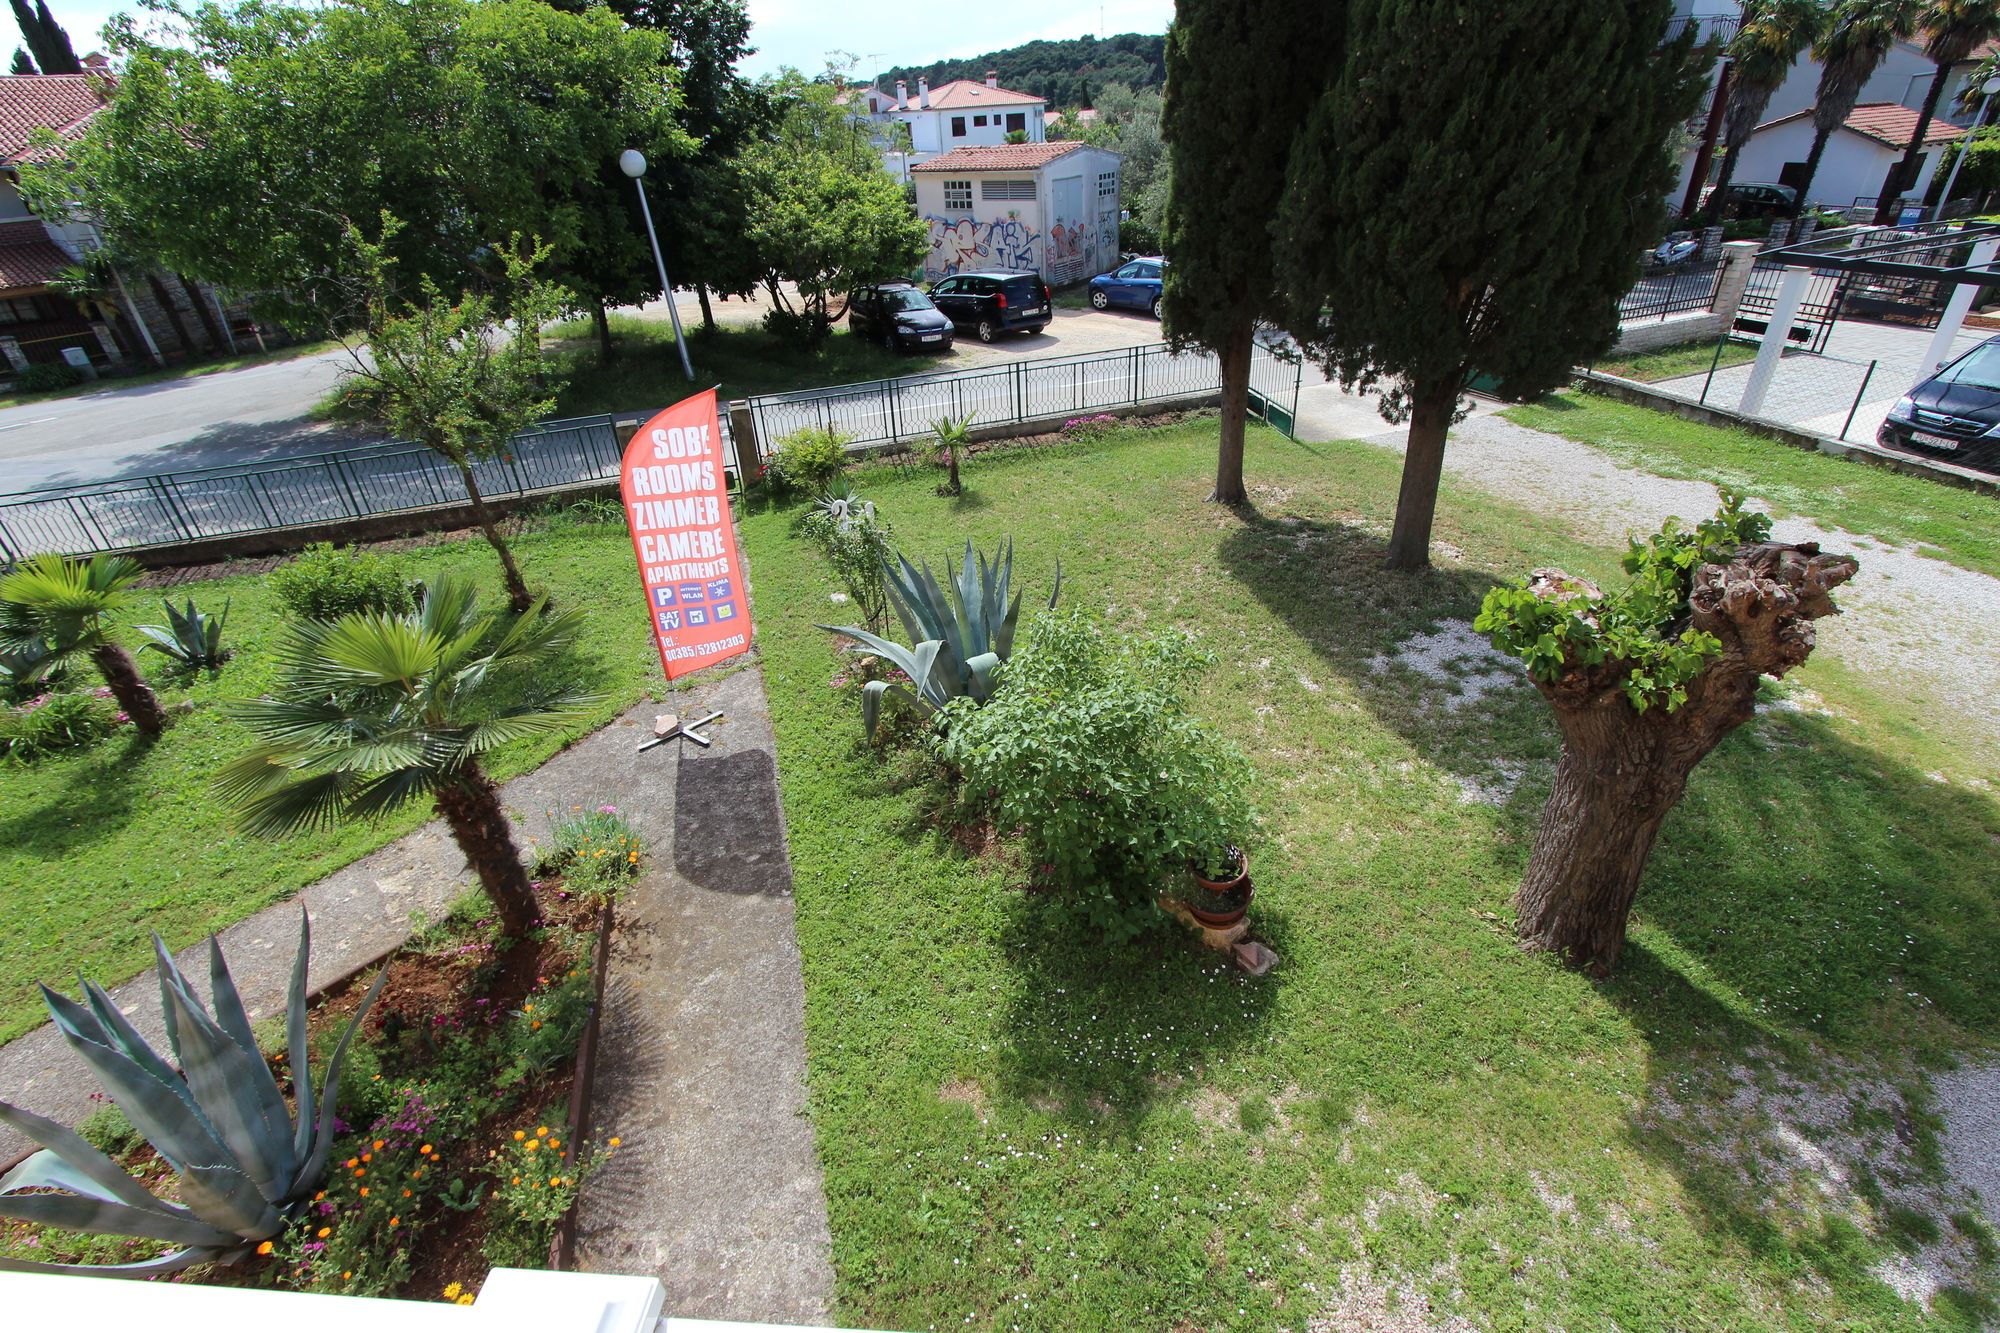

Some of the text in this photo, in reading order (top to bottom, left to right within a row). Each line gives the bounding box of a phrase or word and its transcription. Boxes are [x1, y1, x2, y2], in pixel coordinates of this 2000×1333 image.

[652, 425, 711, 459] SOBE
[632, 461, 716, 496] ROOMS
[632, 497, 720, 531] ZIMMER
[640, 528, 725, 563] CAMERE
[647, 558, 729, 584] APARTMENTS
[707, 578, 729, 588] KLIMA
[657, 588, 672, 606] P
[660, 610, 679, 621] SAT
[661, 618, 680, 630] TV
